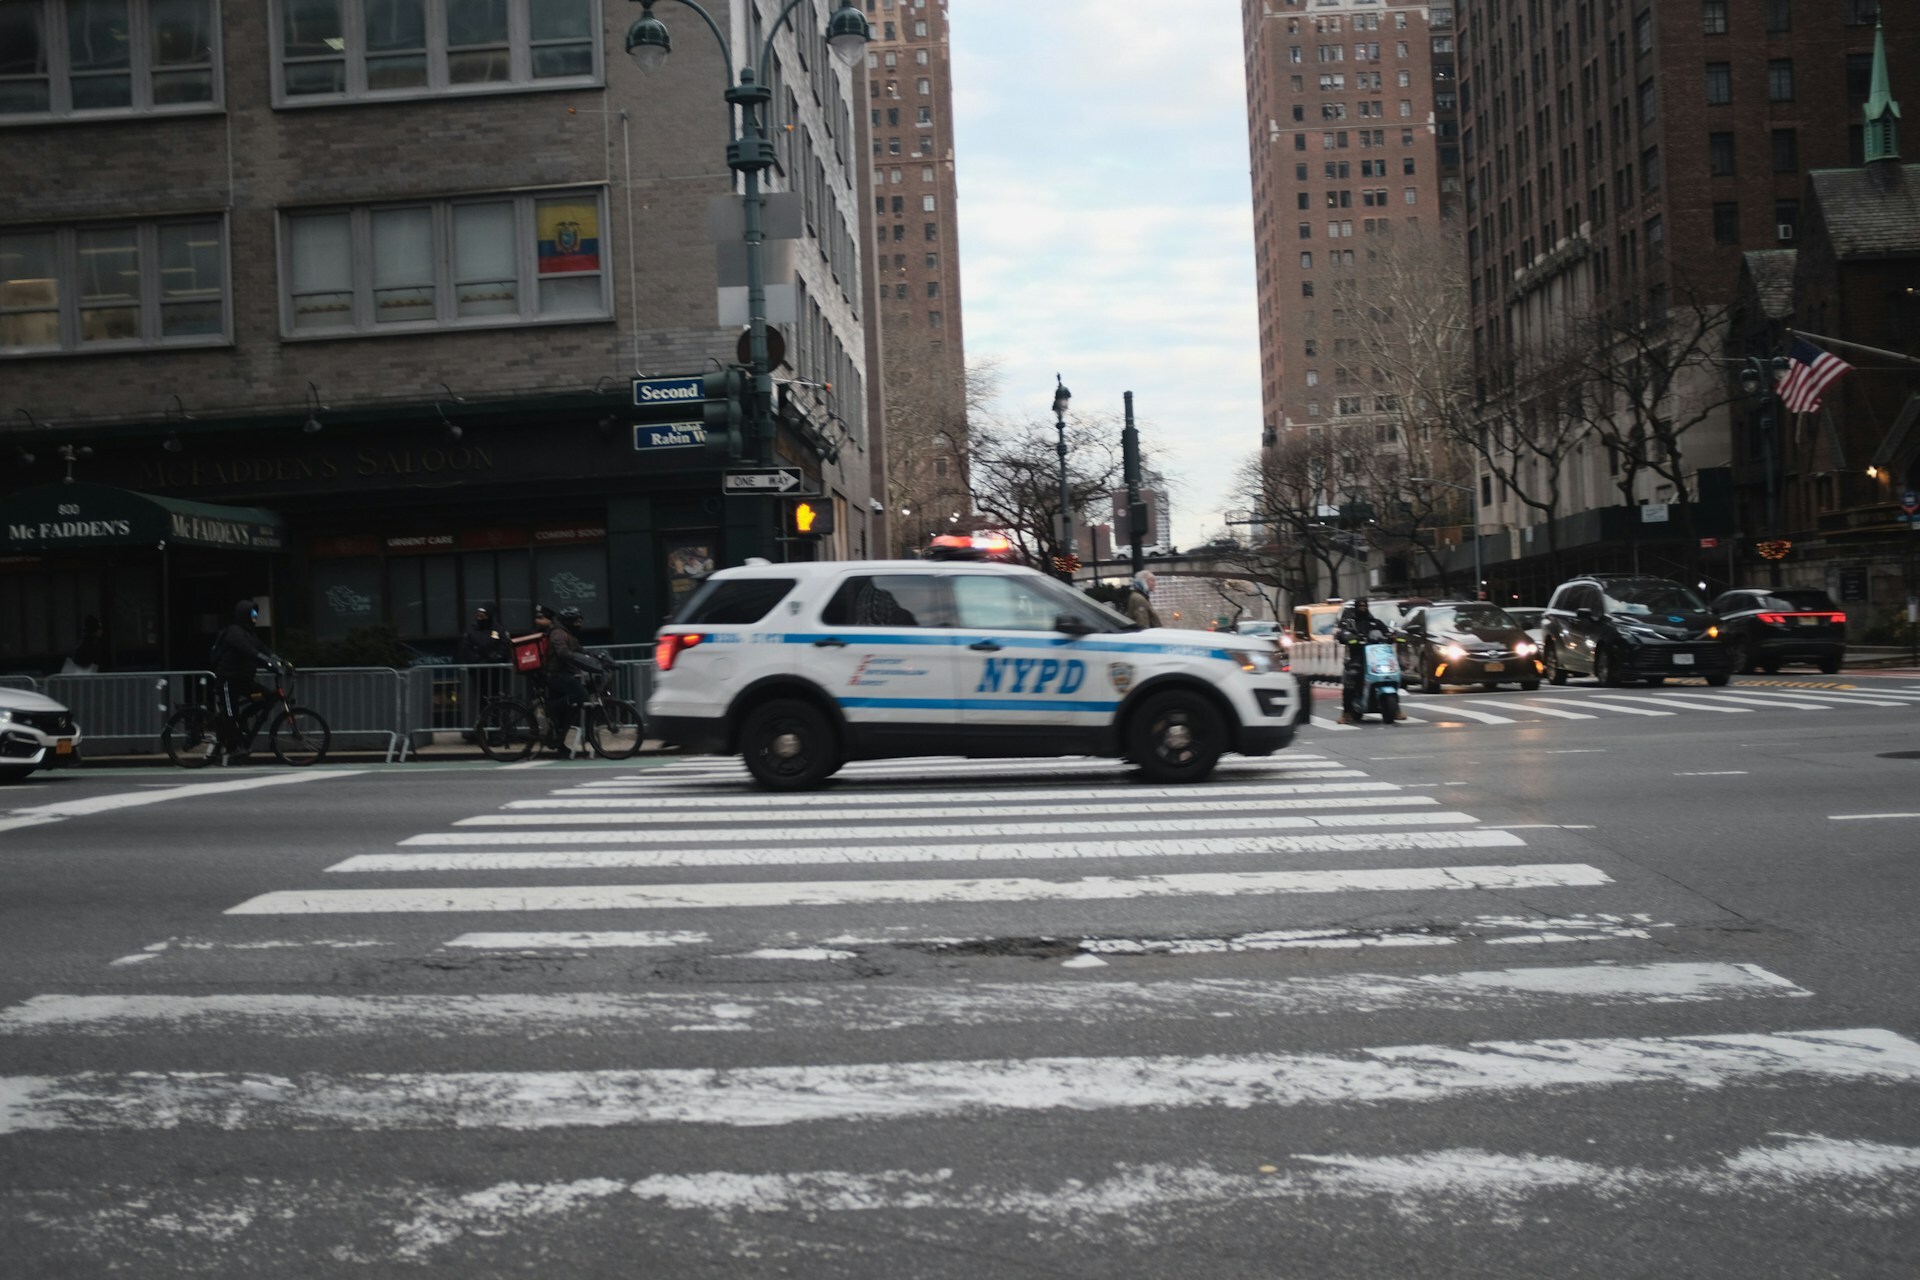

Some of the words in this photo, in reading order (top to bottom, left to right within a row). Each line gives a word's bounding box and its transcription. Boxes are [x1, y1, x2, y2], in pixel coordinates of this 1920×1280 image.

[641, 383, 698, 401] Second
[650, 432, 692, 446] Rabin
[357, 445, 494, 476] SALOON
[734, 476, 756, 487] ONE
[768, 475, 791, 487] WAY
[386, 535, 427, 547] URGENT
[428, 534, 454, 546] CARE
[535, 529, 576, 541] COMING
[576, 527, 607, 539] SOON
[975, 657, 1088, 695] NYPD
